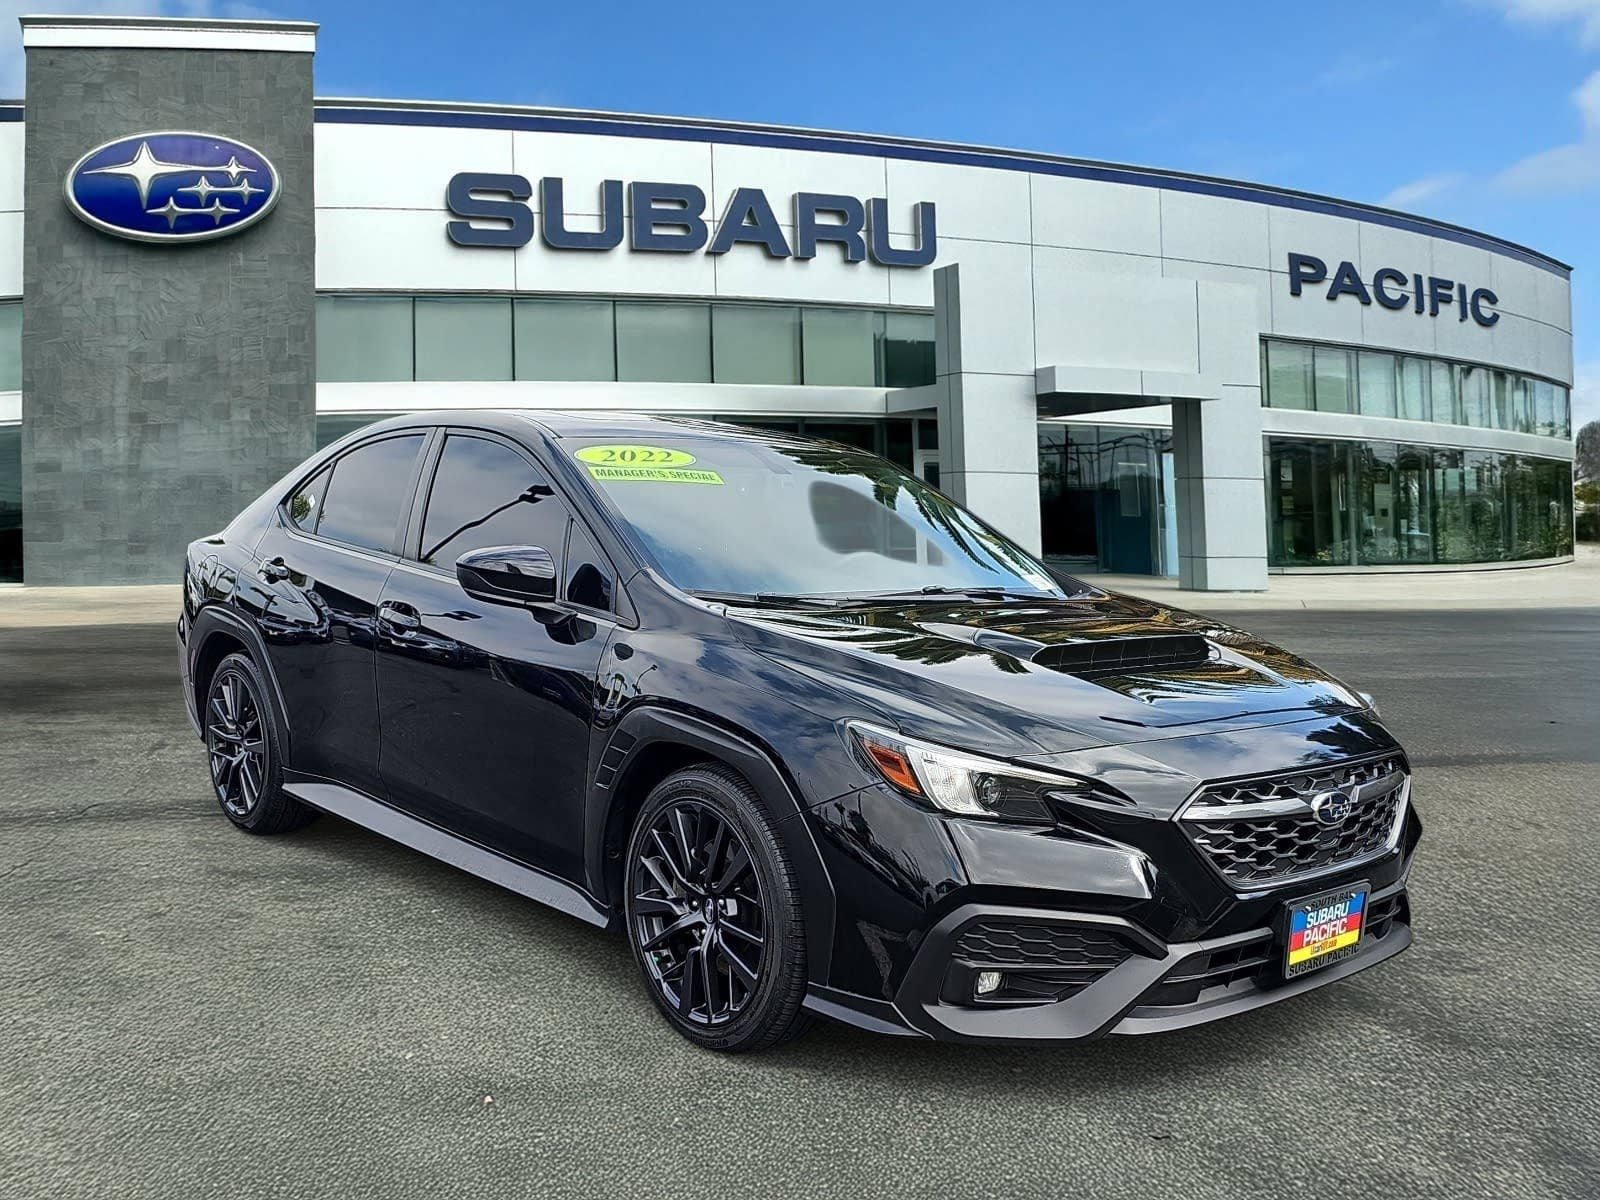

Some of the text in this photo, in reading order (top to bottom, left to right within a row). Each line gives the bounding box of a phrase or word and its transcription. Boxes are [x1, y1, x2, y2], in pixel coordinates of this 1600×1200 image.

[447, 172, 937, 268] SUBARU
[1288, 252, 1500, 327] PACIFIC
[602, 449, 673, 463] 2022
[595, 468, 716, 481] MANAGER'S SPECIAL
[1306, 901, 1350, 928] SUBARU
[1303, 918, 1348, 947] PACIFIC
[1288, 957, 1325, 977] SUBARU
[1327, 944, 1360, 963] PACIFIC
